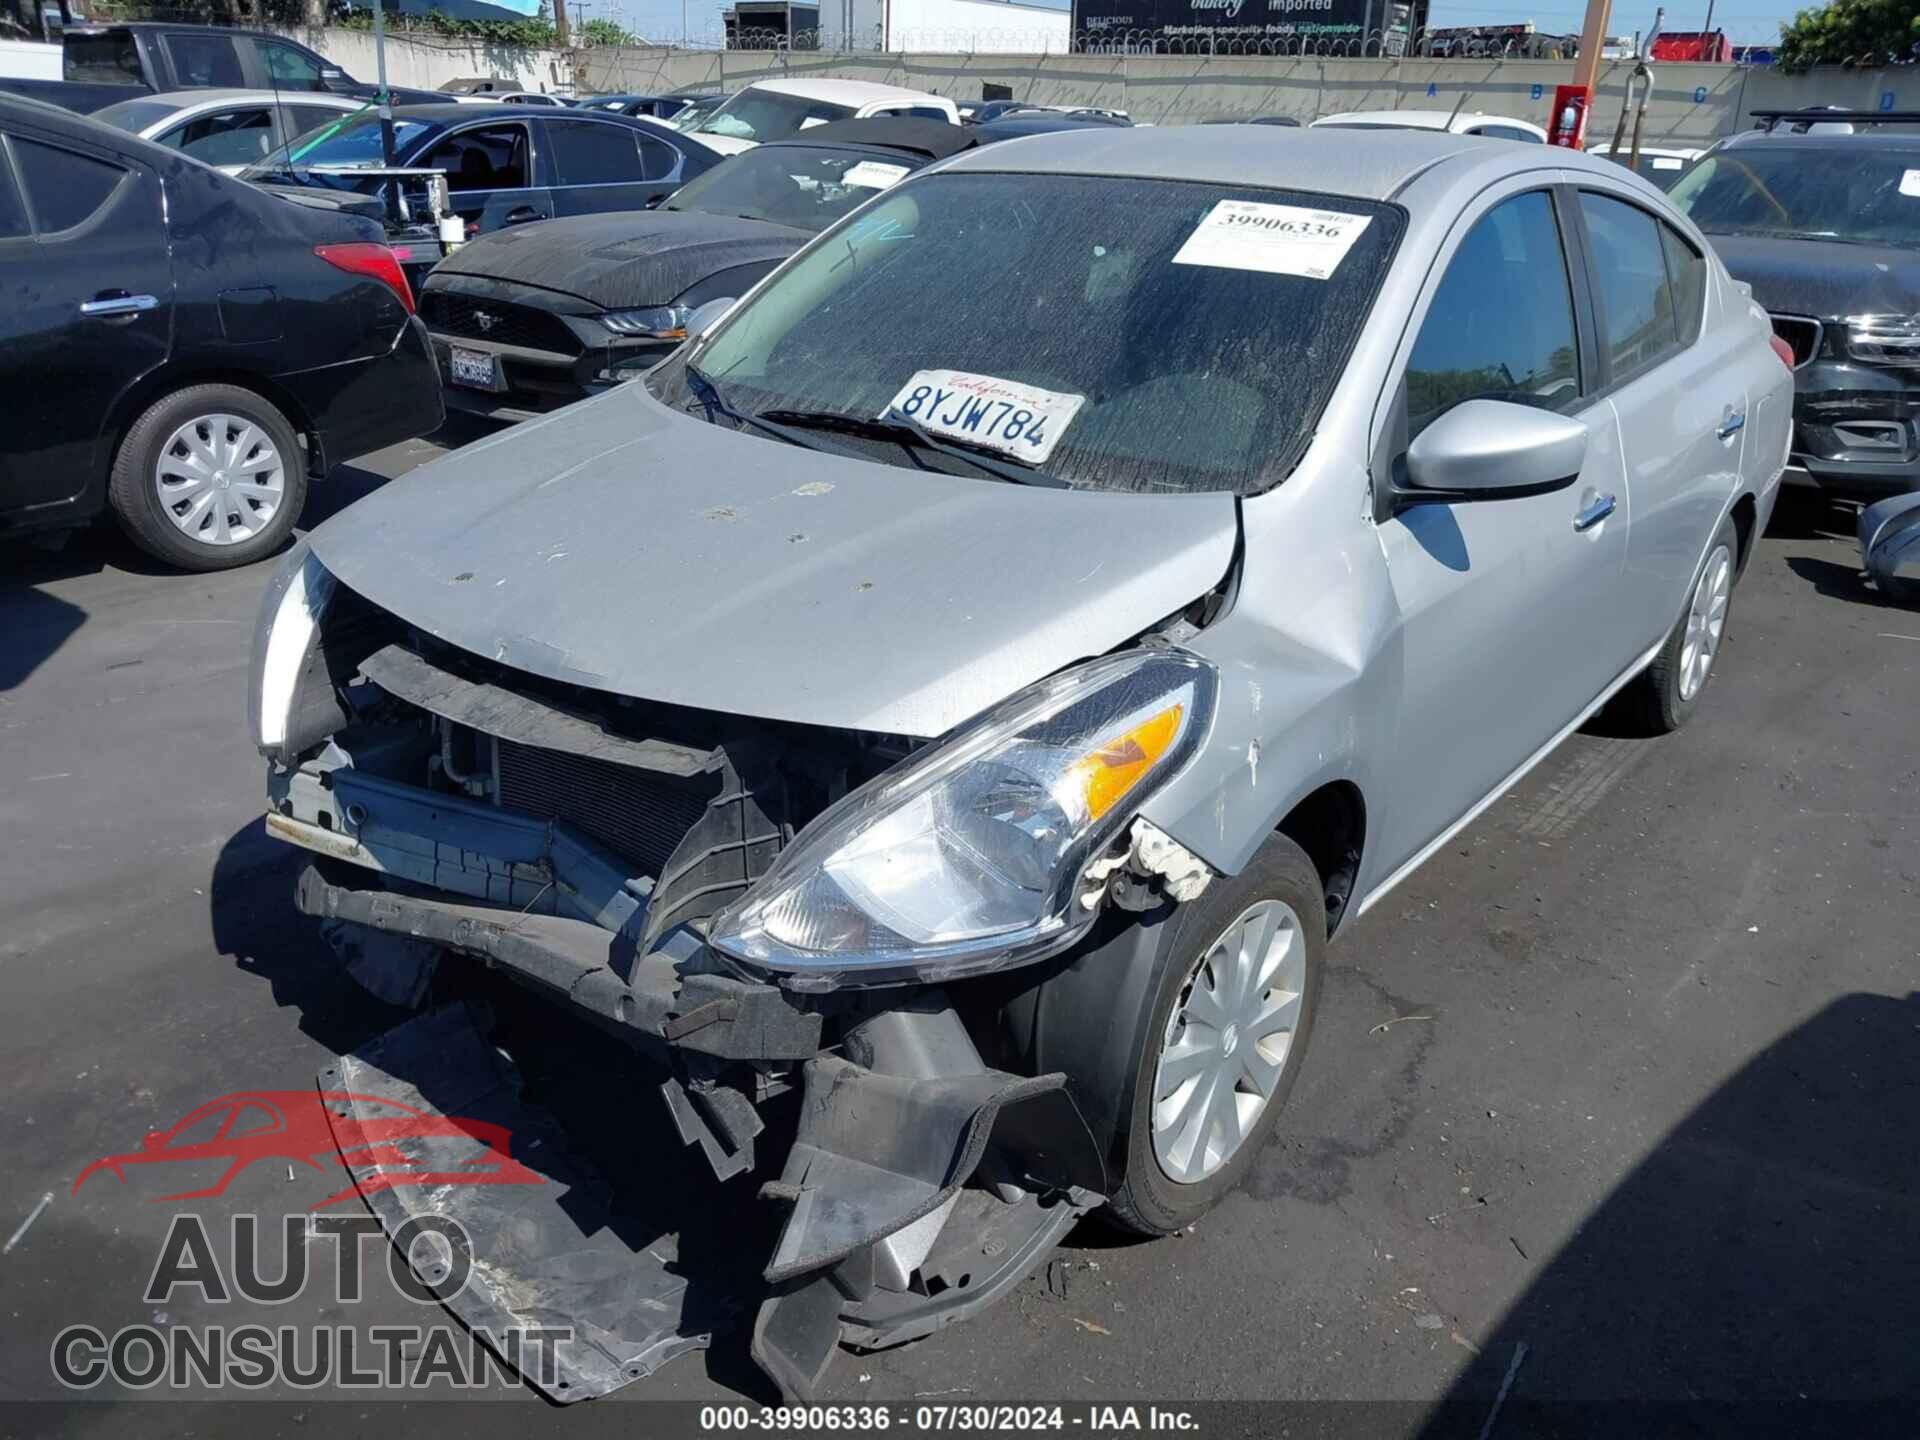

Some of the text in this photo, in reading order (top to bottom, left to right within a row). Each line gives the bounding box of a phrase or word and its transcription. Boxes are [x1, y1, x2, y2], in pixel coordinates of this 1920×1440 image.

[1427, 83, 1436, 97] A
[1531, 84, 1542, 100] B
[1218, 214, 1342, 239] 39906336
[948, 374, 1046, 411] California
[902, 385, 1049, 447] 8YJW784
